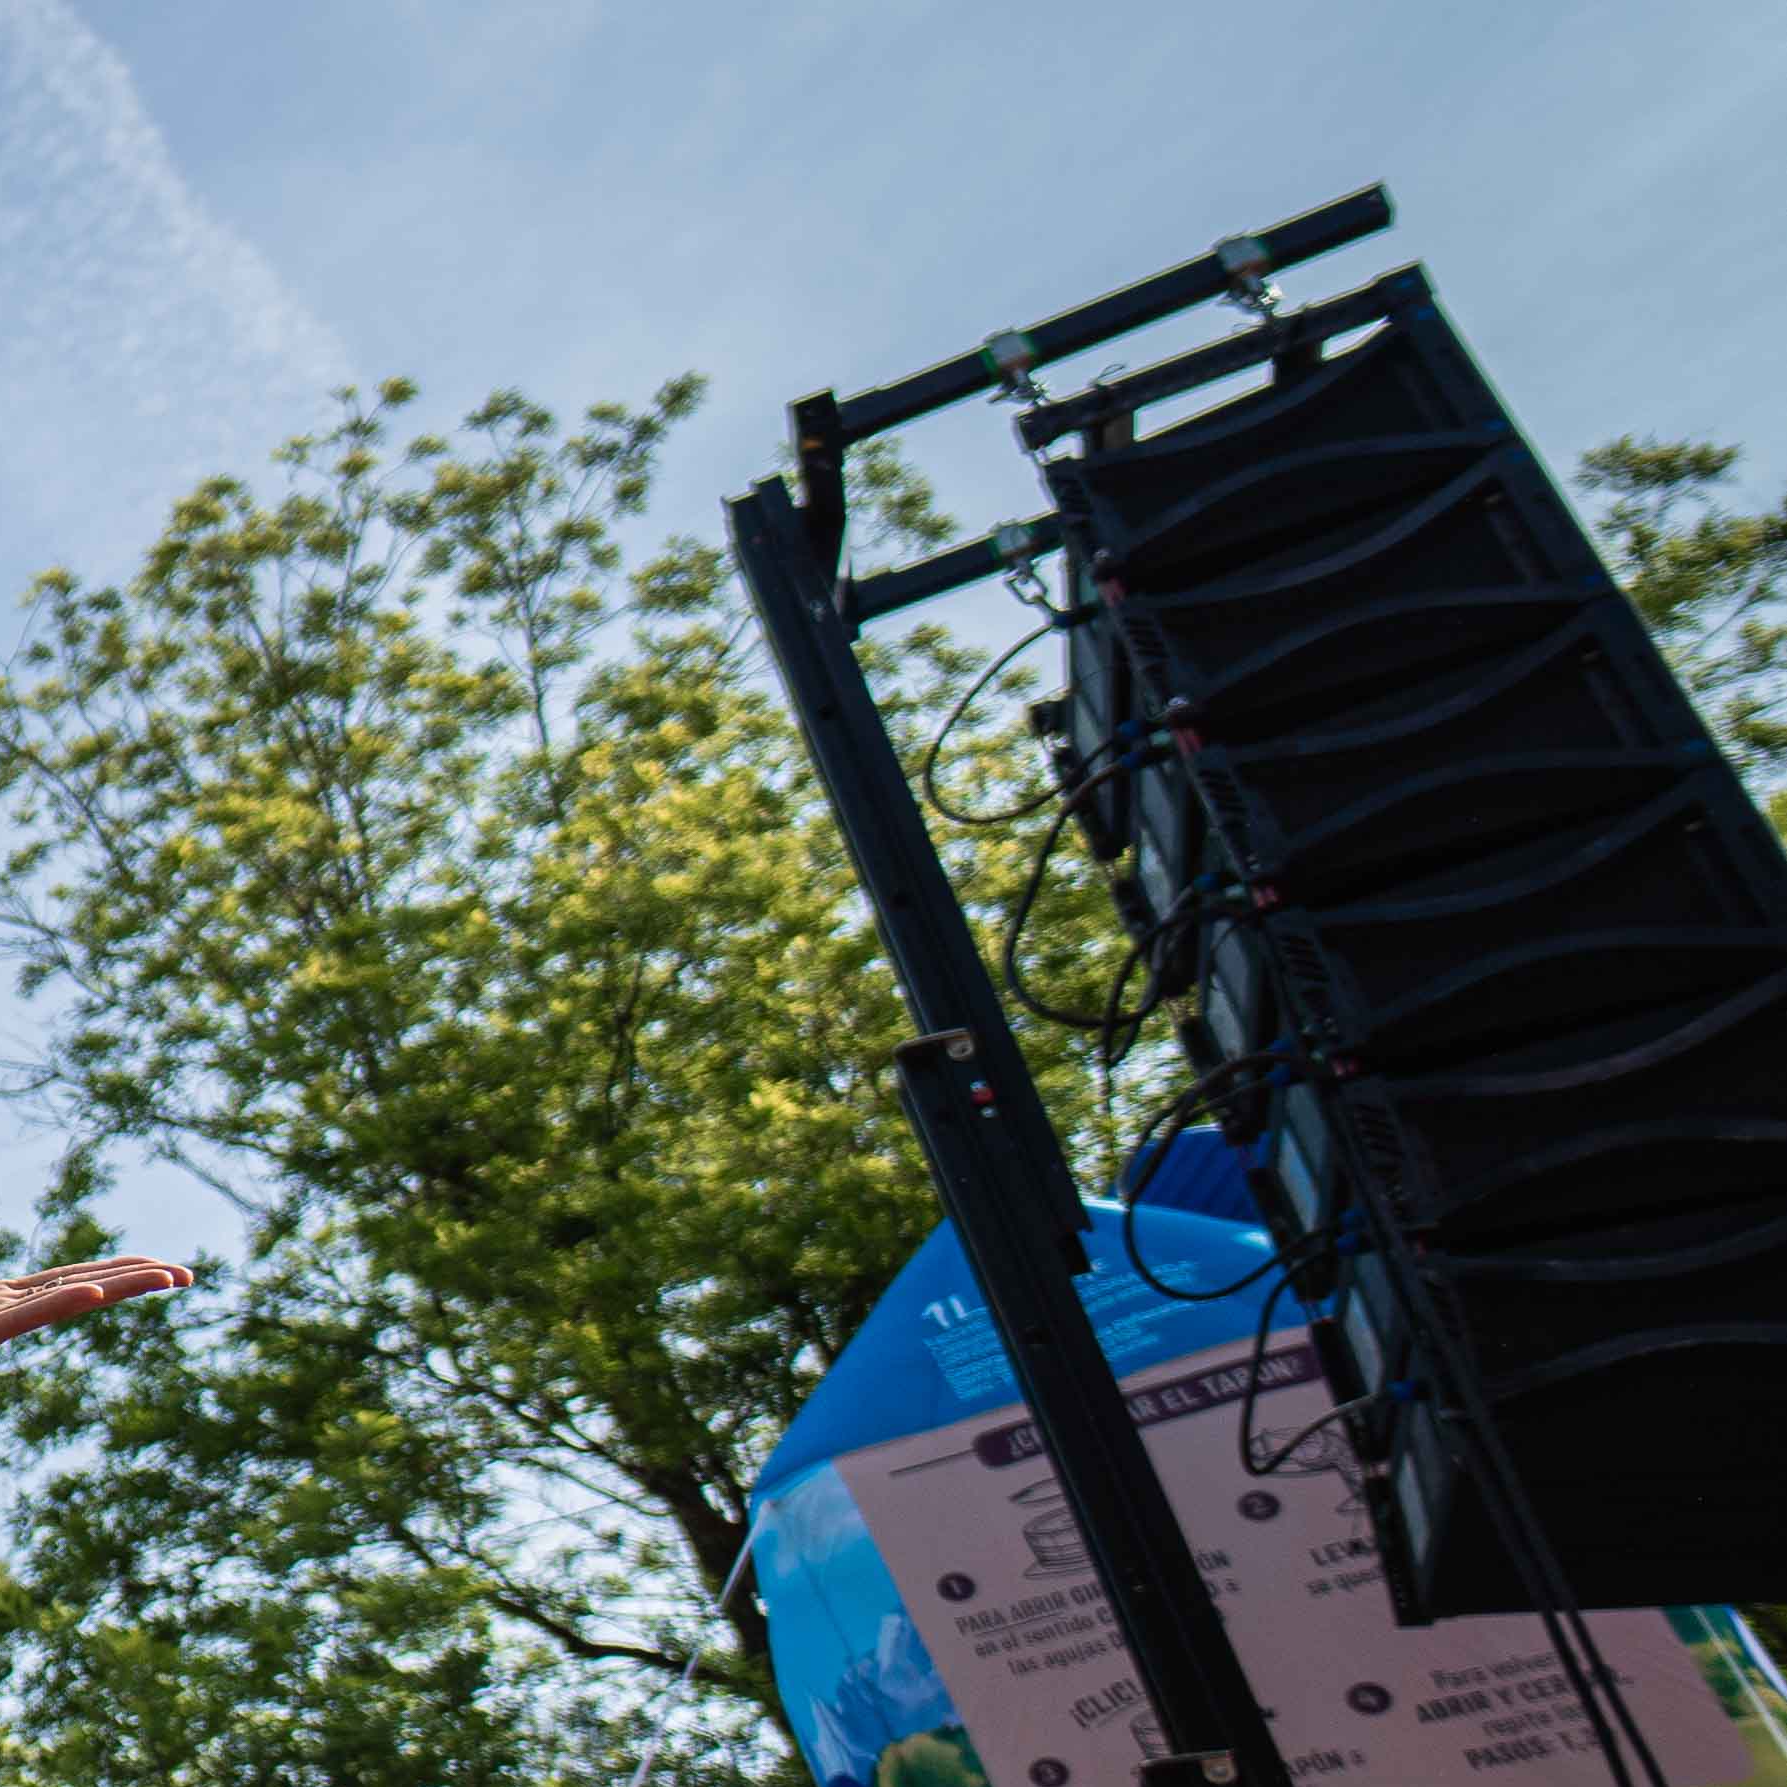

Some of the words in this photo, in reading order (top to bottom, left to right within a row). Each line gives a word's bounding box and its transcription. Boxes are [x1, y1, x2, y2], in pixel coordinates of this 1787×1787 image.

[956, 1607, 1005, 1635] PARA
[1010, 1591, 1065, 1622] ABRIR
[1024, 1615, 1094, 1646] sentido
